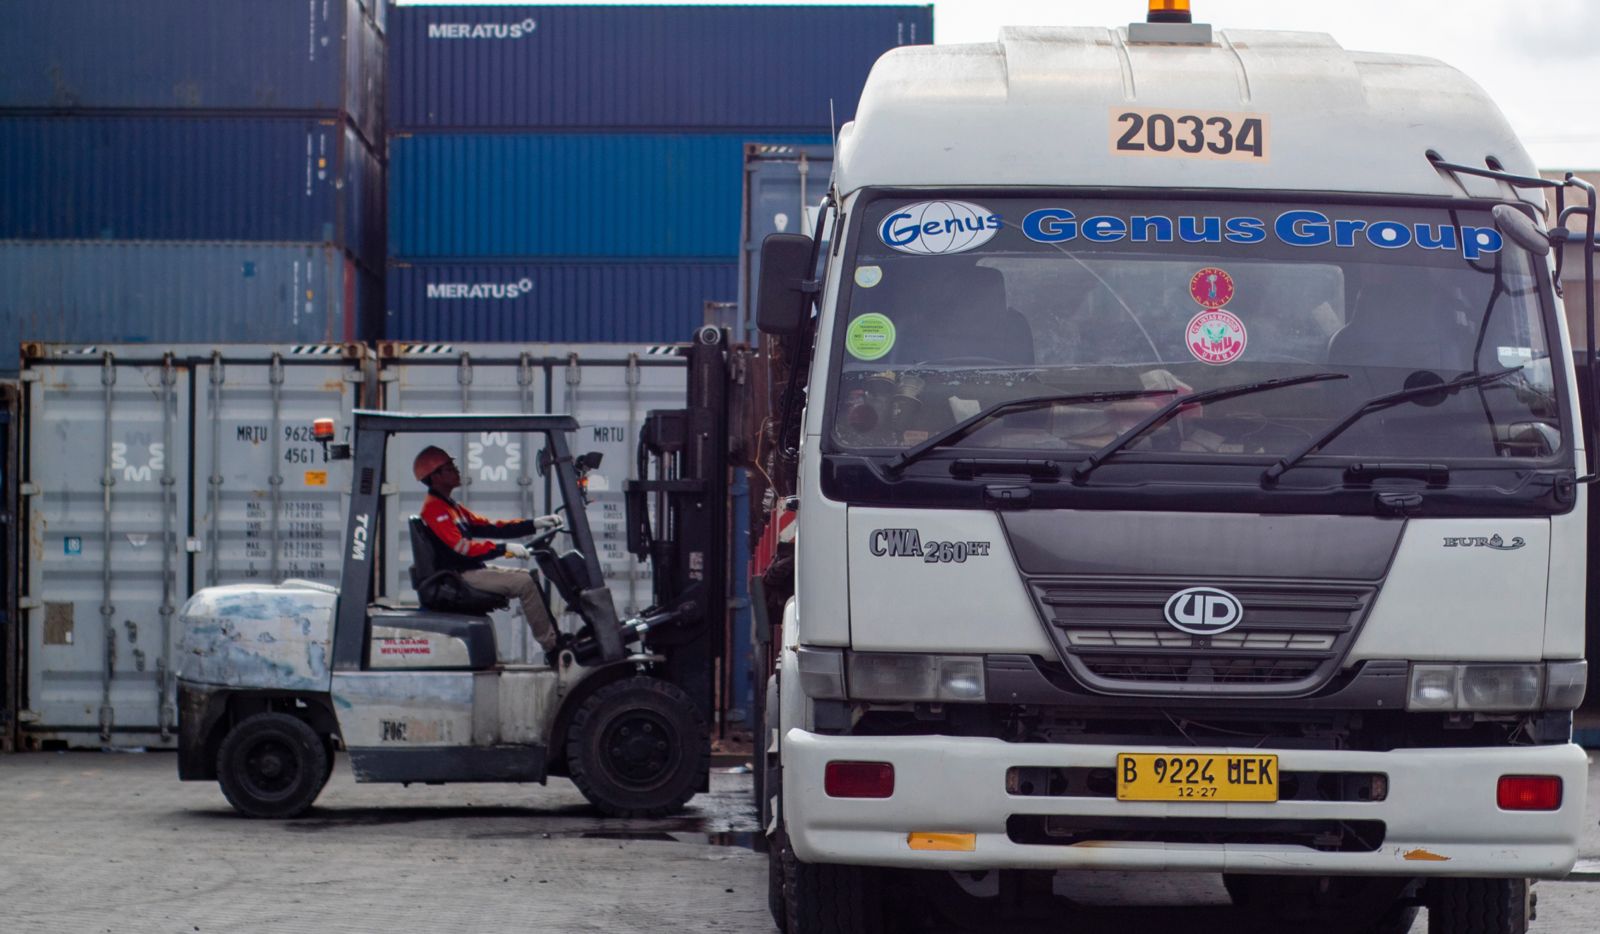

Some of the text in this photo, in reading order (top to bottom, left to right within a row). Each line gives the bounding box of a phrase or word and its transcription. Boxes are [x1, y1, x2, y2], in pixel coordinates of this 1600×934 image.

[428, 24, 522, 38] MERATUS
[1117, 112, 1263, 157] 20334
[882, 212, 1003, 247] Genus
[1021, 208, 1504, 260] Genus Group
[427, 284, 519, 298] MERATUS
[1201, 335, 1232, 354] LMU
[237, 426, 267, 441] MRTU
[594, 427, 624, 442] MRTU
[352, 513, 369, 561] TCM
[869, 528, 924, 557] CWA
[1174, 594, 1237, 625] UD
[1123, 758, 1137, 783] B
[1154, 758, 1214, 784] 9224
